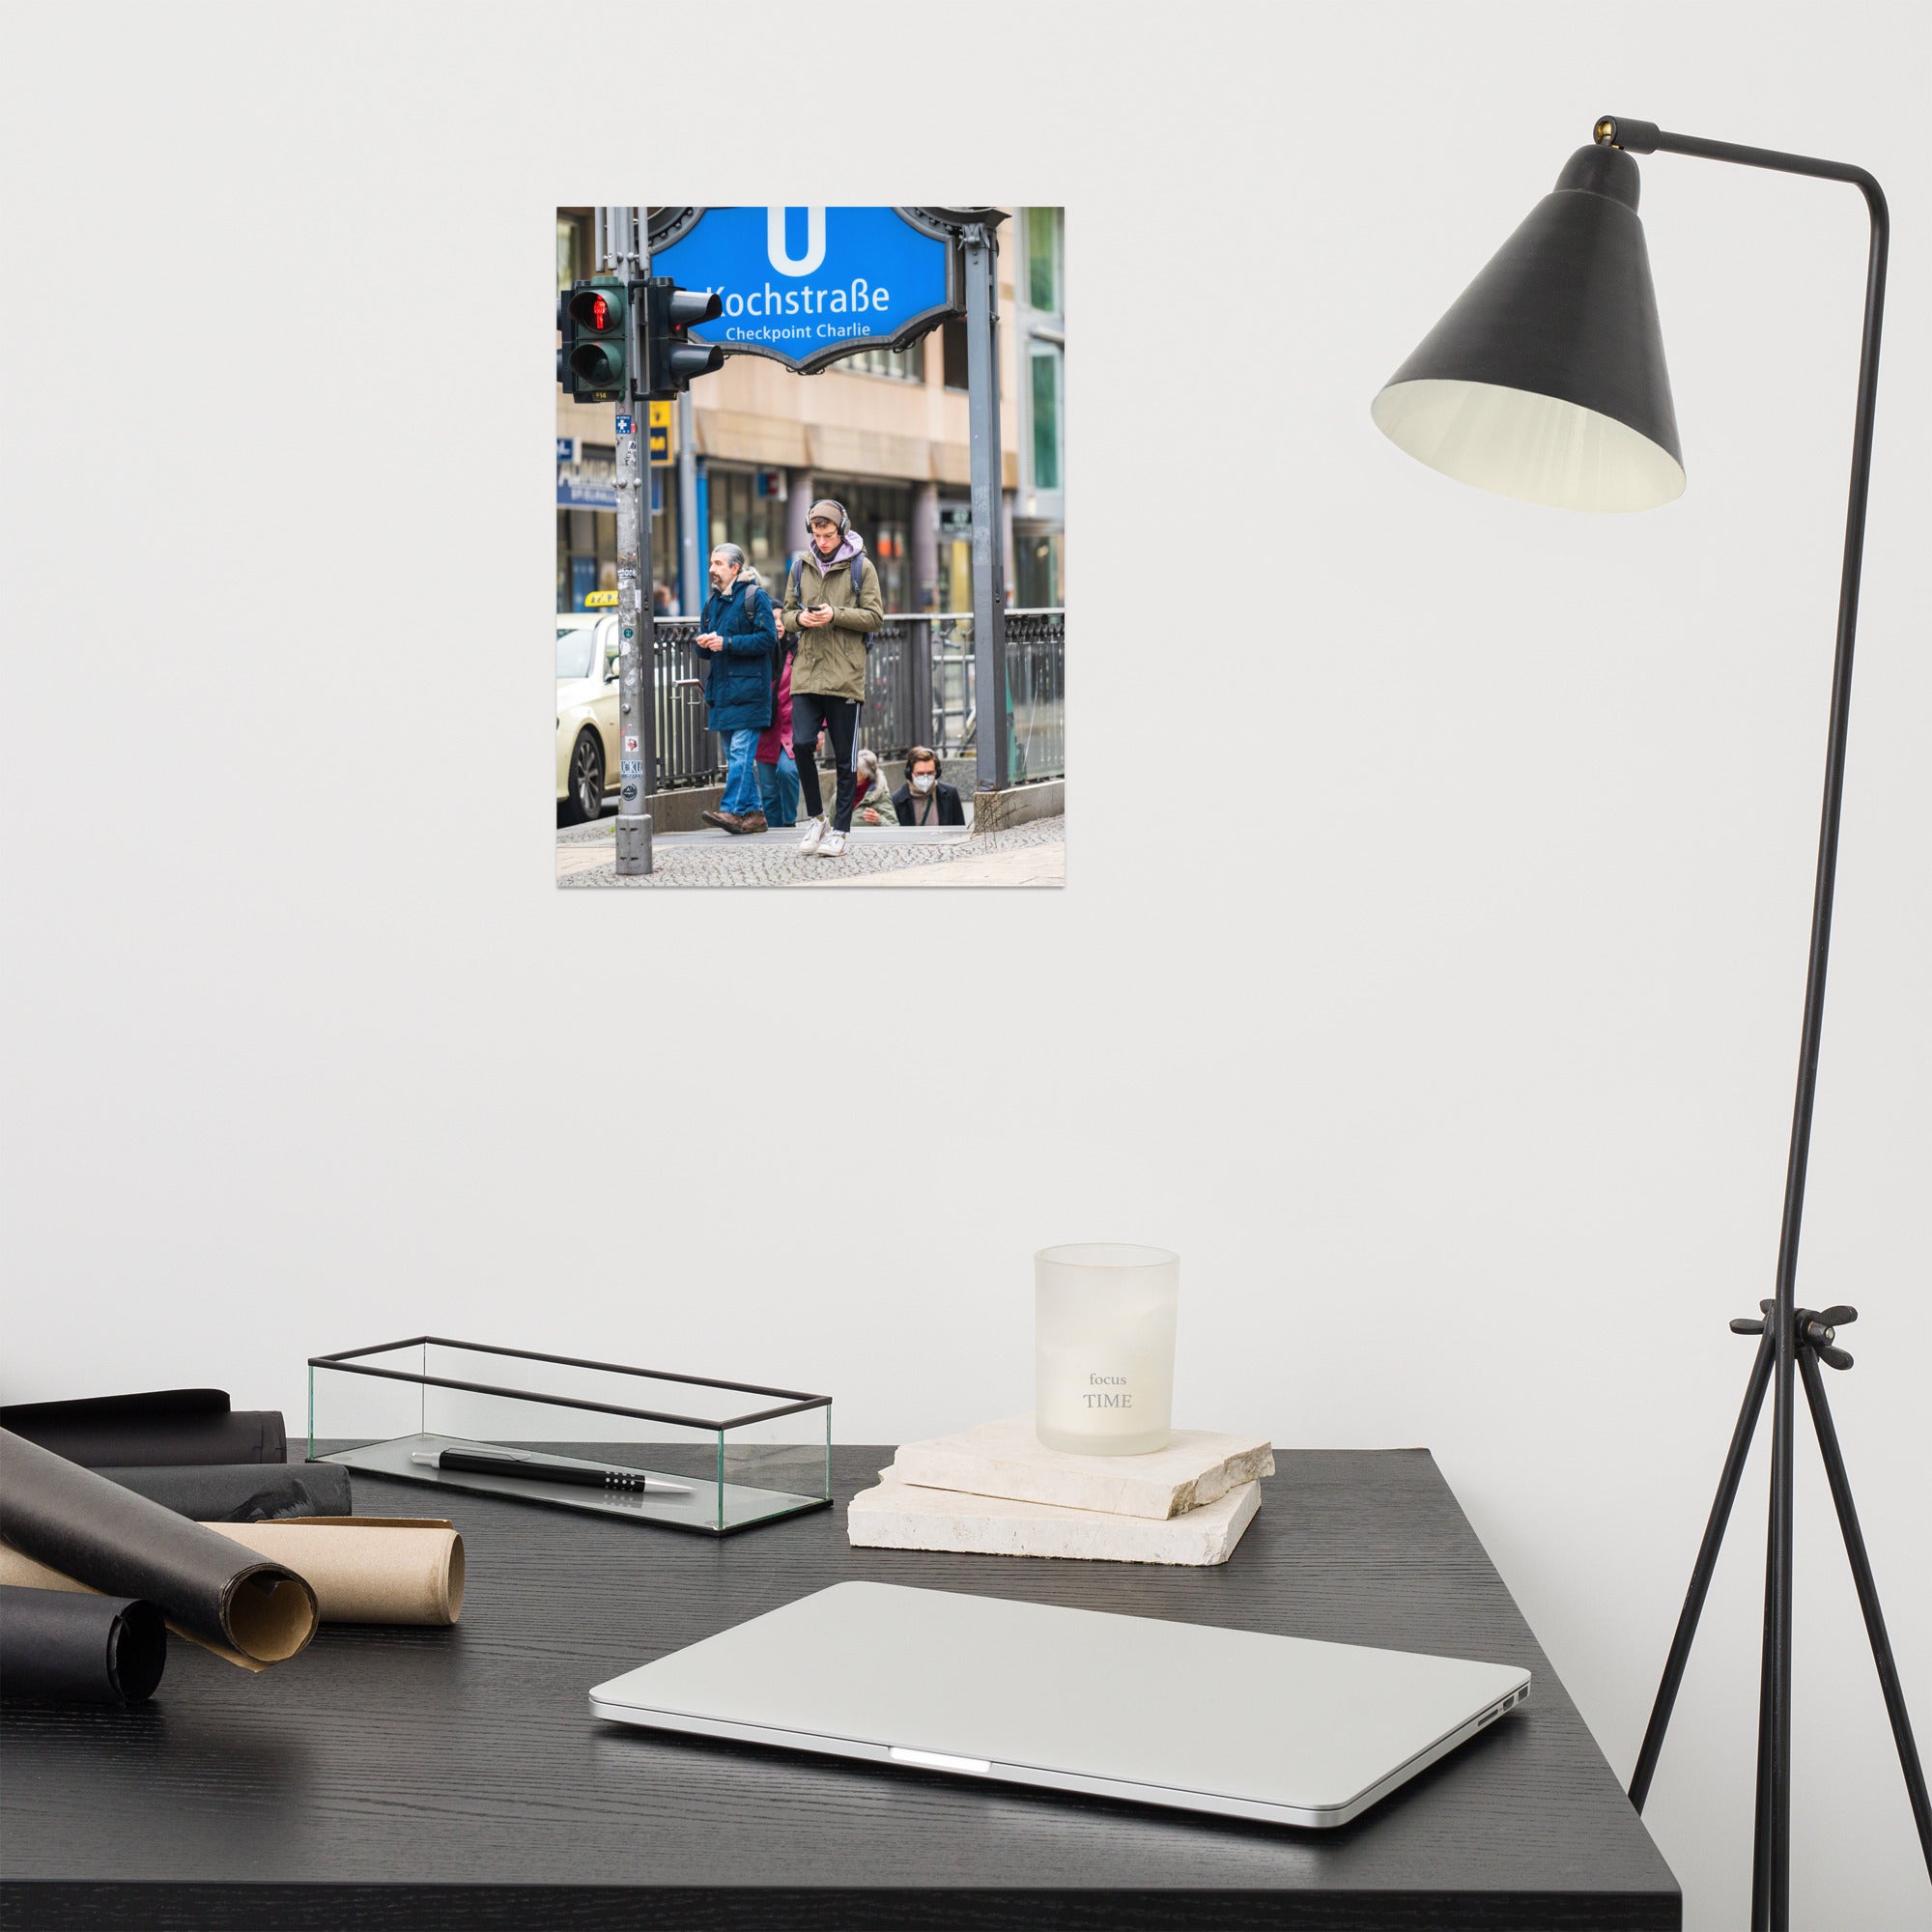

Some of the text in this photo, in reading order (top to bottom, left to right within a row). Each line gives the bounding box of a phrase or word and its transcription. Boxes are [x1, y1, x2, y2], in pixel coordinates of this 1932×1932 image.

[767, 206, 826, 277] U
[725, 322, 871, 343] Checkpoint Charlie
[1089, 1373, 1127, 1385] focus
[1082, 1394, 1133, 1408] TIME
